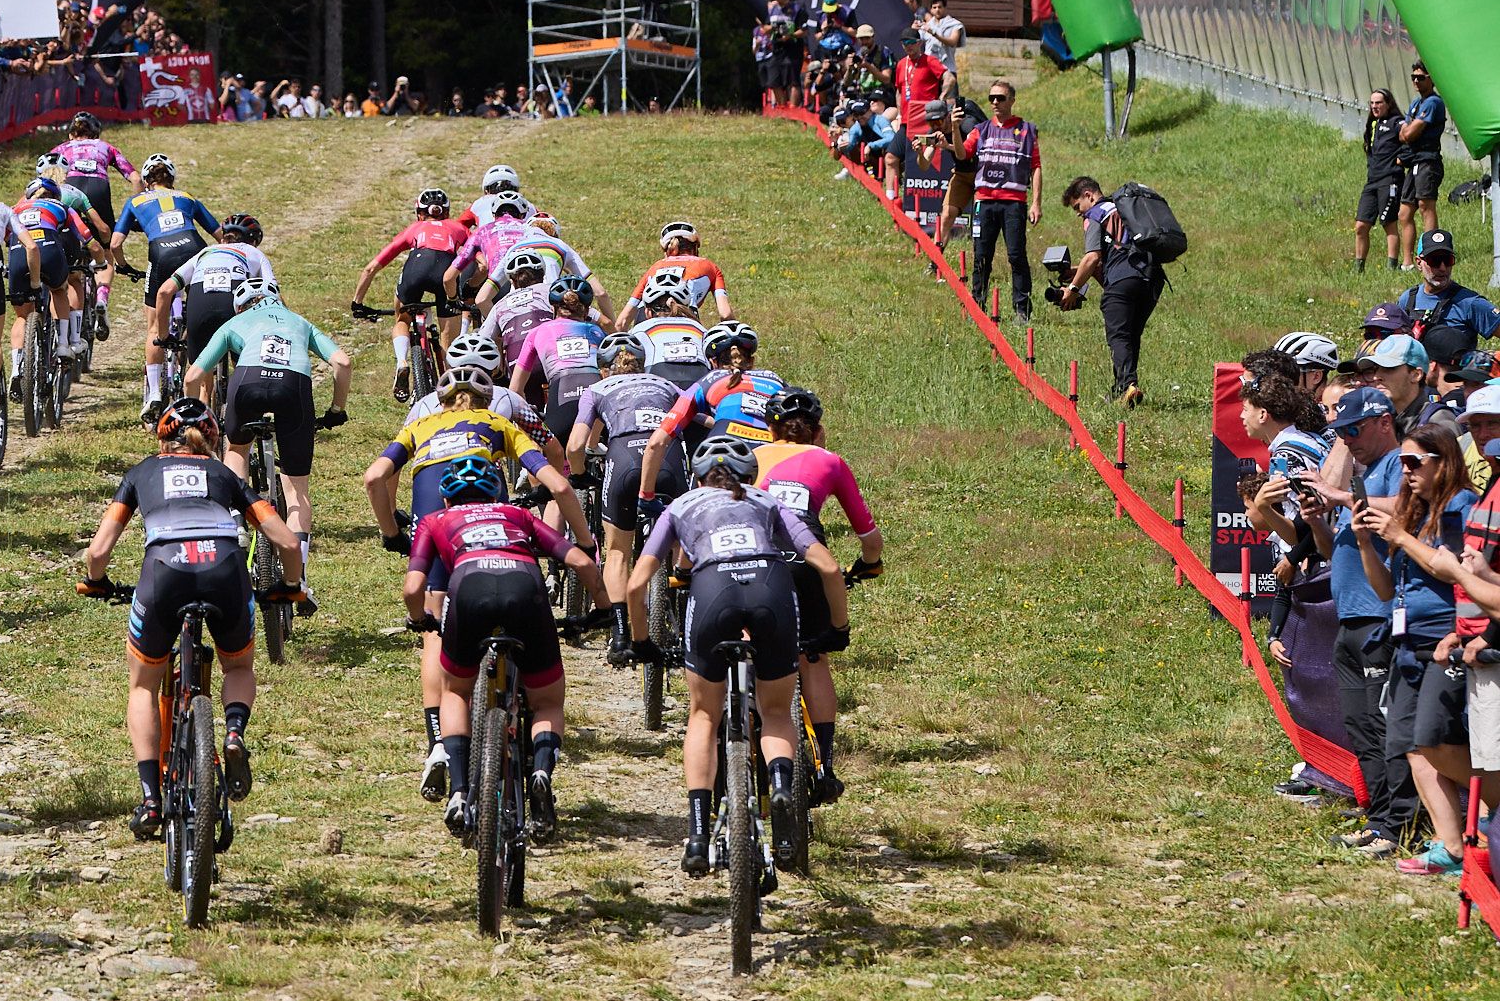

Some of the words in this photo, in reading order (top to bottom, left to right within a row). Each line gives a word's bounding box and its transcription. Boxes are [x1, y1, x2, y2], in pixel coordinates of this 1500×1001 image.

[987, 169, 1005, 178] 052
[906, 179, 939, 189] DROP
[906, 189, 942, 198] FINISH
[164, 216, 179, 226] 69
[160, 237, 191, 248] CANYON
[209, 275, 227, 285] 12
[266, 343, 285, 356] 34
[563, 342, 584, 351] 32
[1309, 352, 1338, 369] S-WORKS
[261, 370, 284, 378] BIXS
[642, 413, 663, 423] 28
[171, 474, 200, 487] 60
[776, 490, 802, 503] 47
[471, 527, 498, 540] 55
[1216, 530, 1270, 545] STAR
[720, 533, 748, 547] 53
[430, 713, 442, 741] ROUVY
